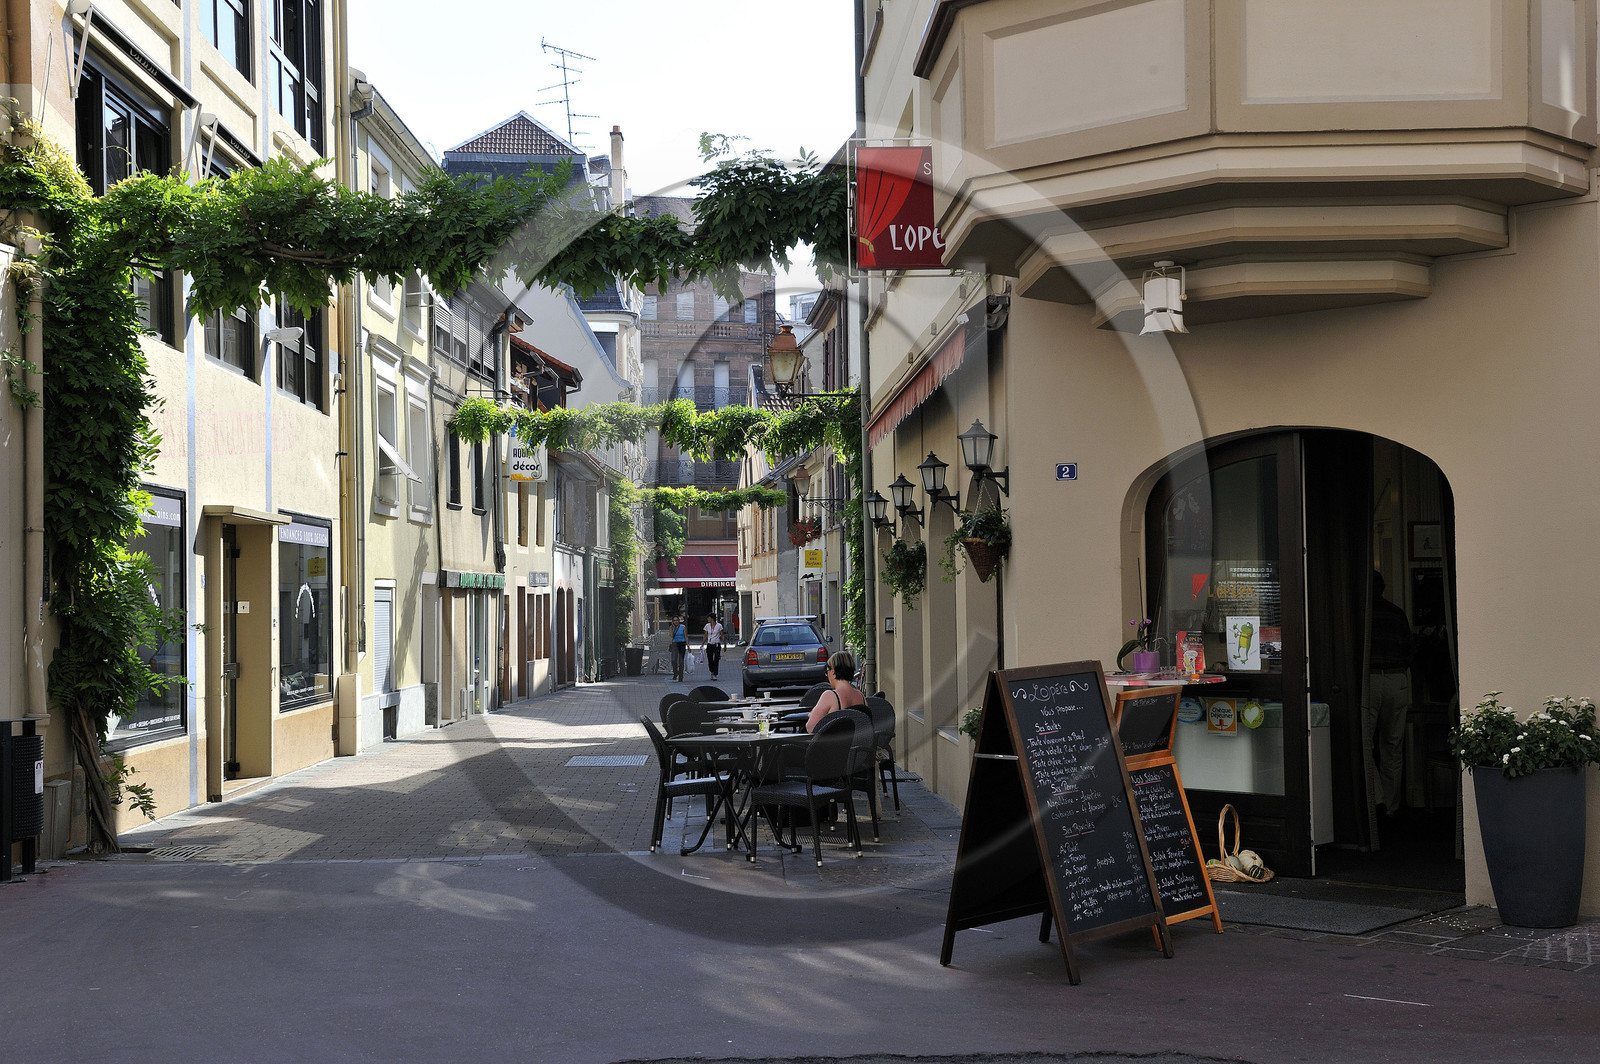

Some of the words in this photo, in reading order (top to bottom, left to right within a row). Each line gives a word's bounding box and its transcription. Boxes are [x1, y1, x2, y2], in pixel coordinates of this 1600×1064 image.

[512, 448, 530, 459] AQU
[512, 461, 540, 471] décor
[1062, 466, 1070, 477] 2
[314, 532, 329, 545] DESIGN
[1211, 703, 1232, 715] Chèque
[1210, 711, 1233, 721] Déjeuner
